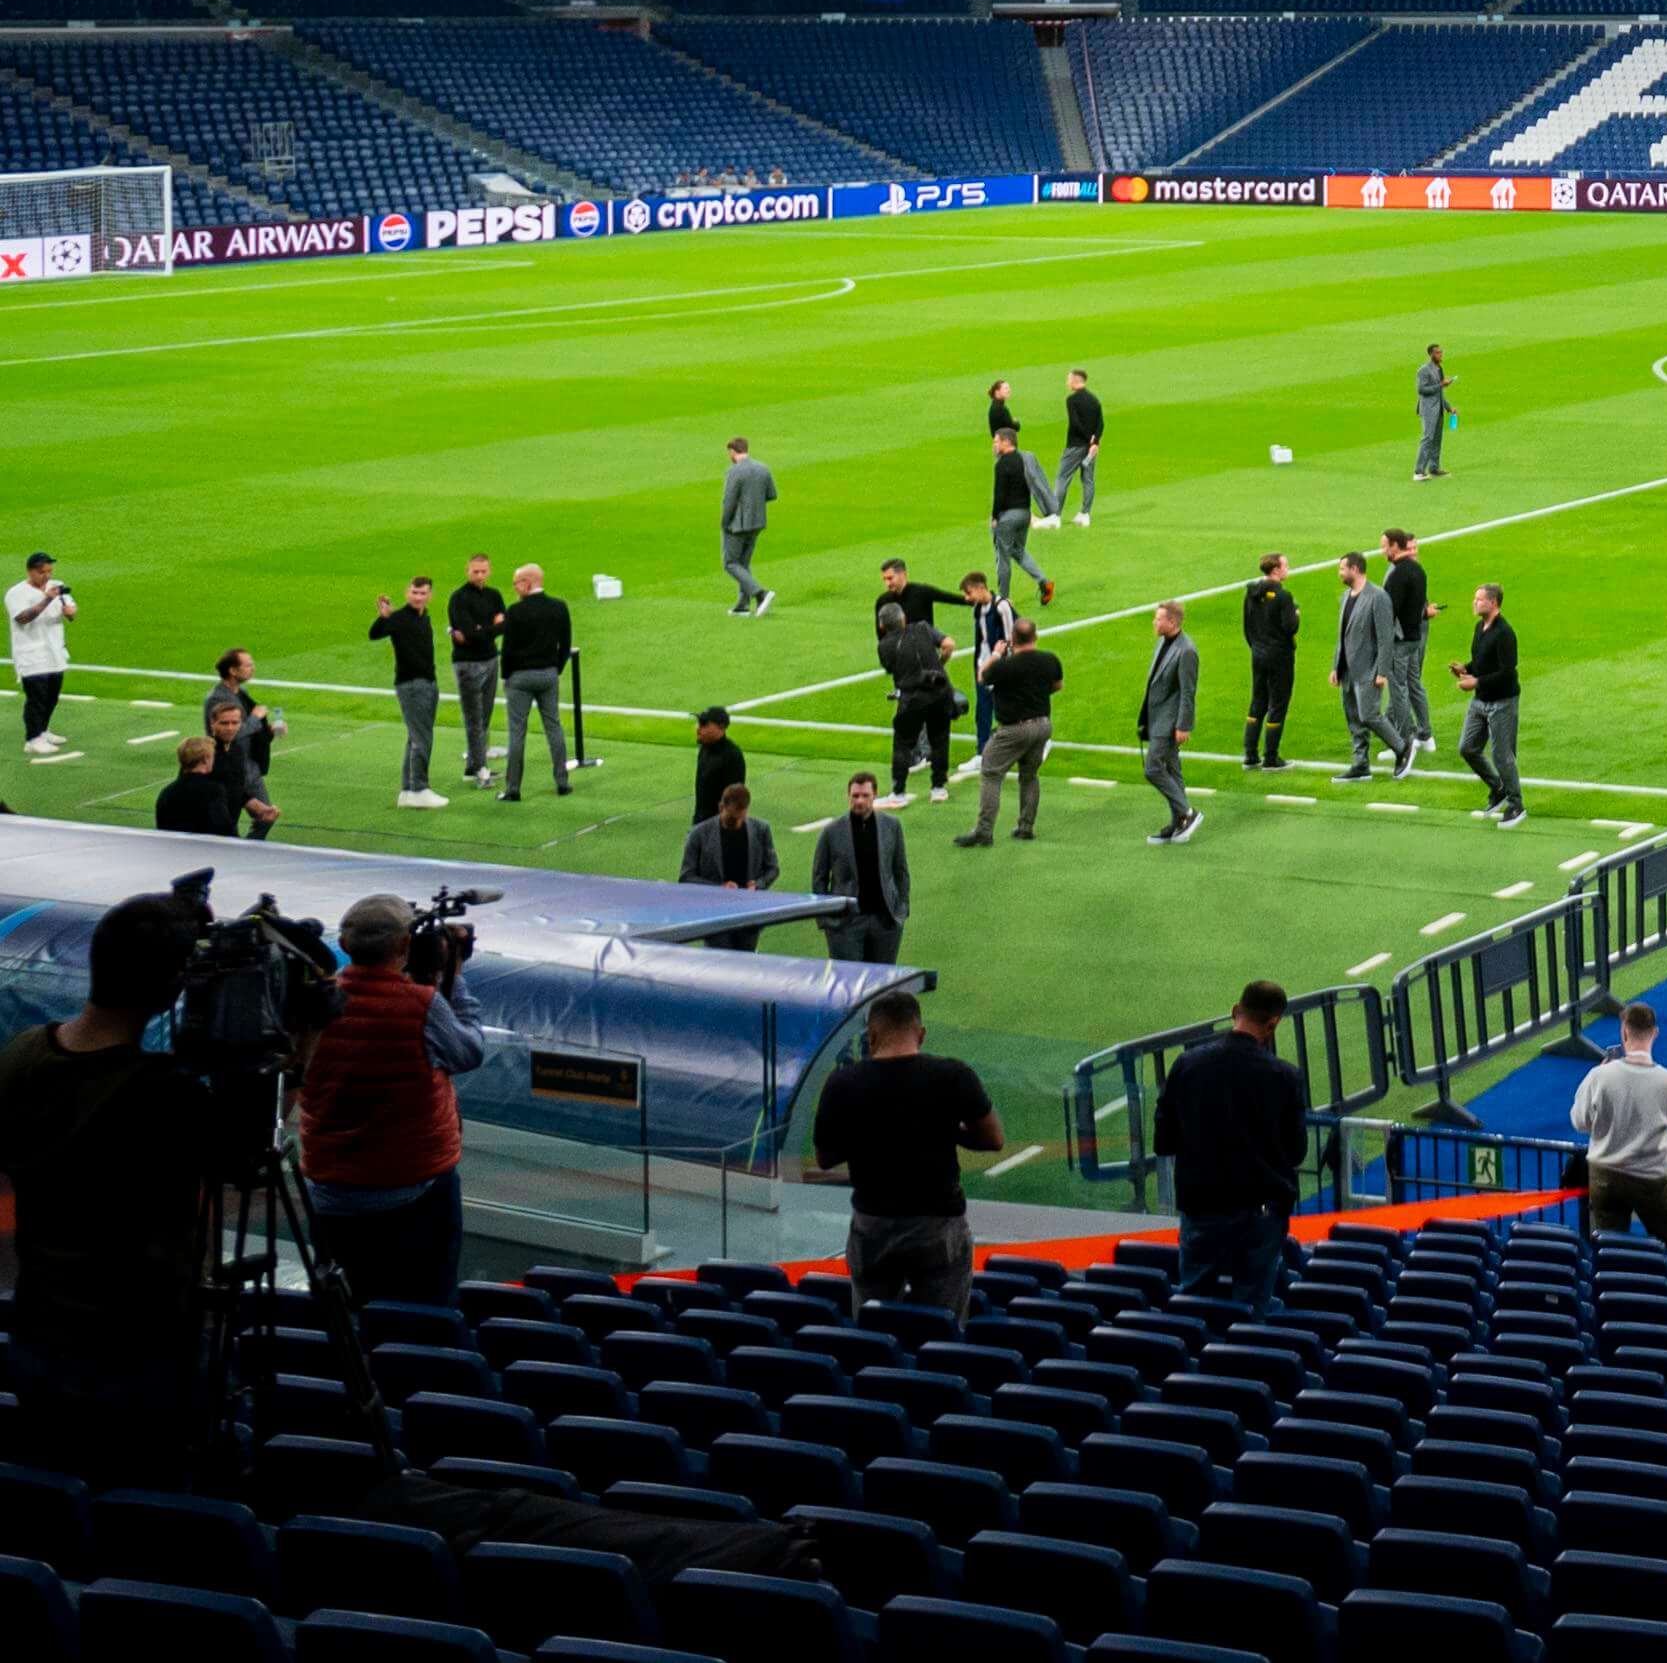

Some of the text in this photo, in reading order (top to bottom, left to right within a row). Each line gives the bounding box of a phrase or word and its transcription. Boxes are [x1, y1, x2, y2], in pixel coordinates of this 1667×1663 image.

[917, 182, 987, 208] PS5
[1154, 179, 1315, 202] mastercard
[426, 203, 556, 248] PEPSI
[658, 192, 819, 230] crypto.com
[105, 221, 356, 267] QATAR AIRWAYS
